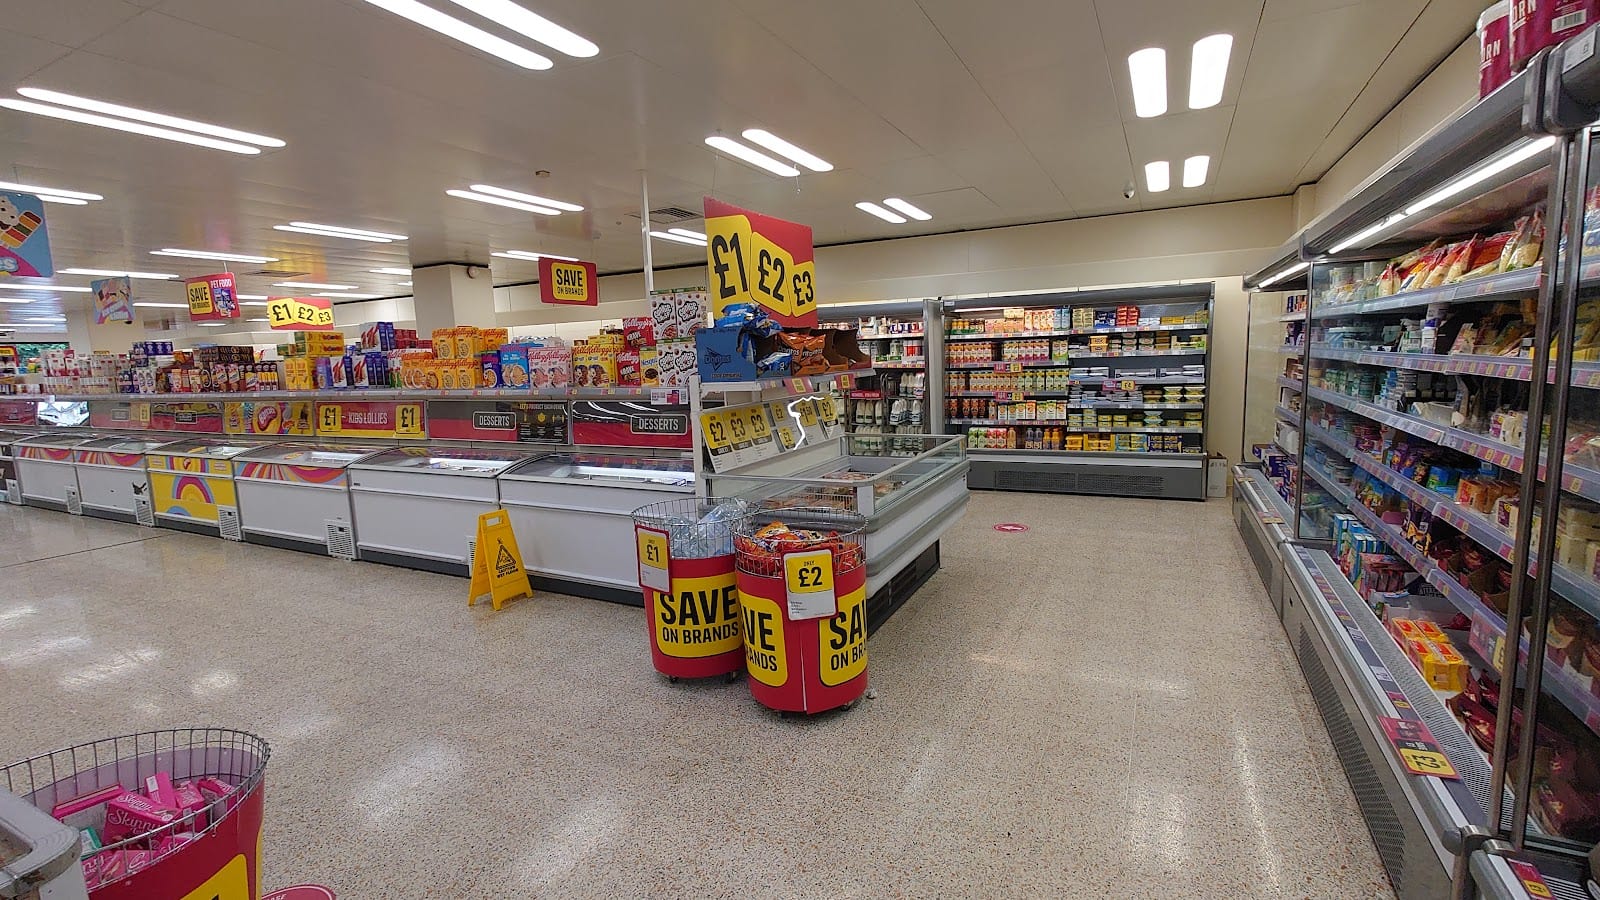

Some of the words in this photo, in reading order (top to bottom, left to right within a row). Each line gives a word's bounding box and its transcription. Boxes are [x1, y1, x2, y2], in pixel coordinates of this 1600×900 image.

[556, 268, 583, 287] SAVE
[711, 232, 748, 299] £1
[758, 249, 784, 302] £2
[793, 271, 814, 306] £3
[210, 279, 219, 289] PET
[219, 278, 232, 288] FOOD
[557, 286, 564, 294] ON
[565, 287, 584, 296] BRANDS
[189, 286, 208, 302] SAVE
[272, 303, 291, 322] £1
[297, 306, 314, 322] £2
[319, 311, 331, 323] £3
[324, 406, 337, 426] £1
[363, 411, 388, 425] LOLLIES
[401, 407, 415, 427] £1
[479, 415, 510, 427] DESSERTS
[638, 418, 679, 431] DESSERTS
[750, 414, 765, 433] £3
[709, 421, 727, 443] £2
[730, 418, 746, 438] £3
[646, 544, 659, 562] £1
[798, 566, 823, 588] £2
[660, 584, 738, 626] SAVE
[662, 626, 679, 644] ON
[682, 621, 739, 645] BRANDS
[742, 605, 776, 652] VE
[830, 650, 849, 671] ON
